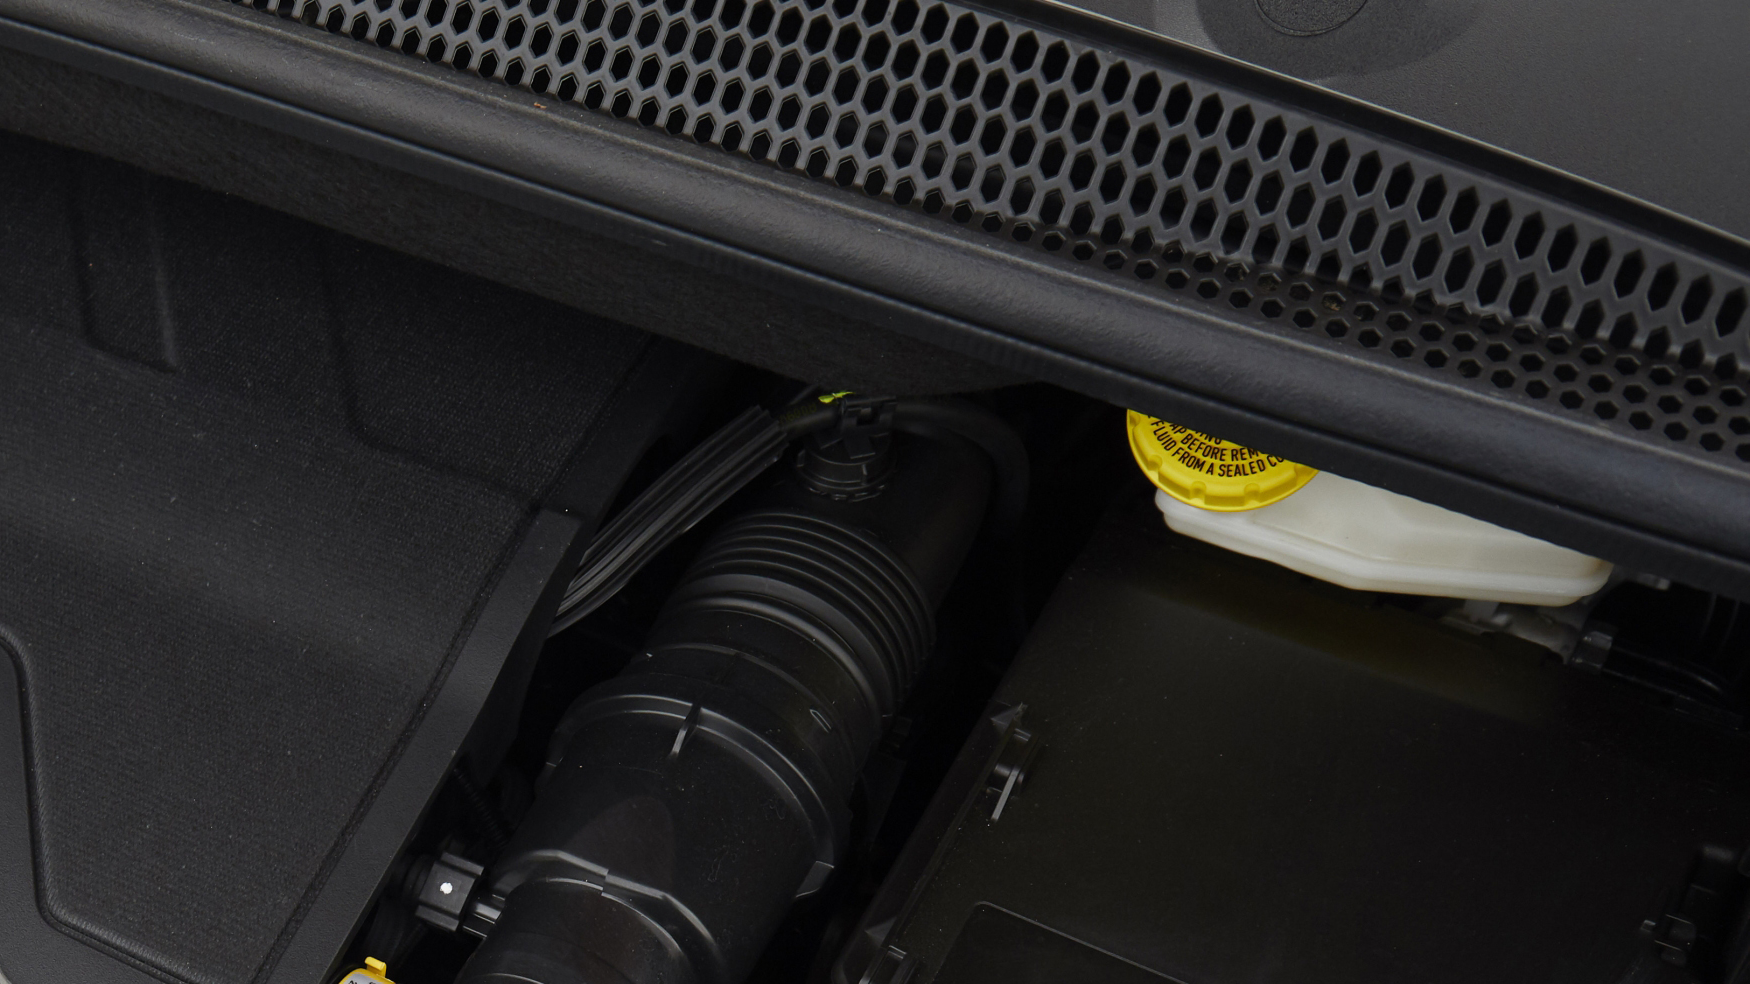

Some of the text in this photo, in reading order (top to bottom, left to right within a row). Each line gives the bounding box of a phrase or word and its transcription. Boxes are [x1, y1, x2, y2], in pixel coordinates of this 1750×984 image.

[1150, 420, 1178, 452] FLUID
[1171, 447, 1206, 473] FROM
[1206, 462, 1215, 476] A
[1217, 459, 1267, 478] SEALED
[1180, 433, 1228, 462] BEFORE
[1230, 446, 1260, 462] REM
